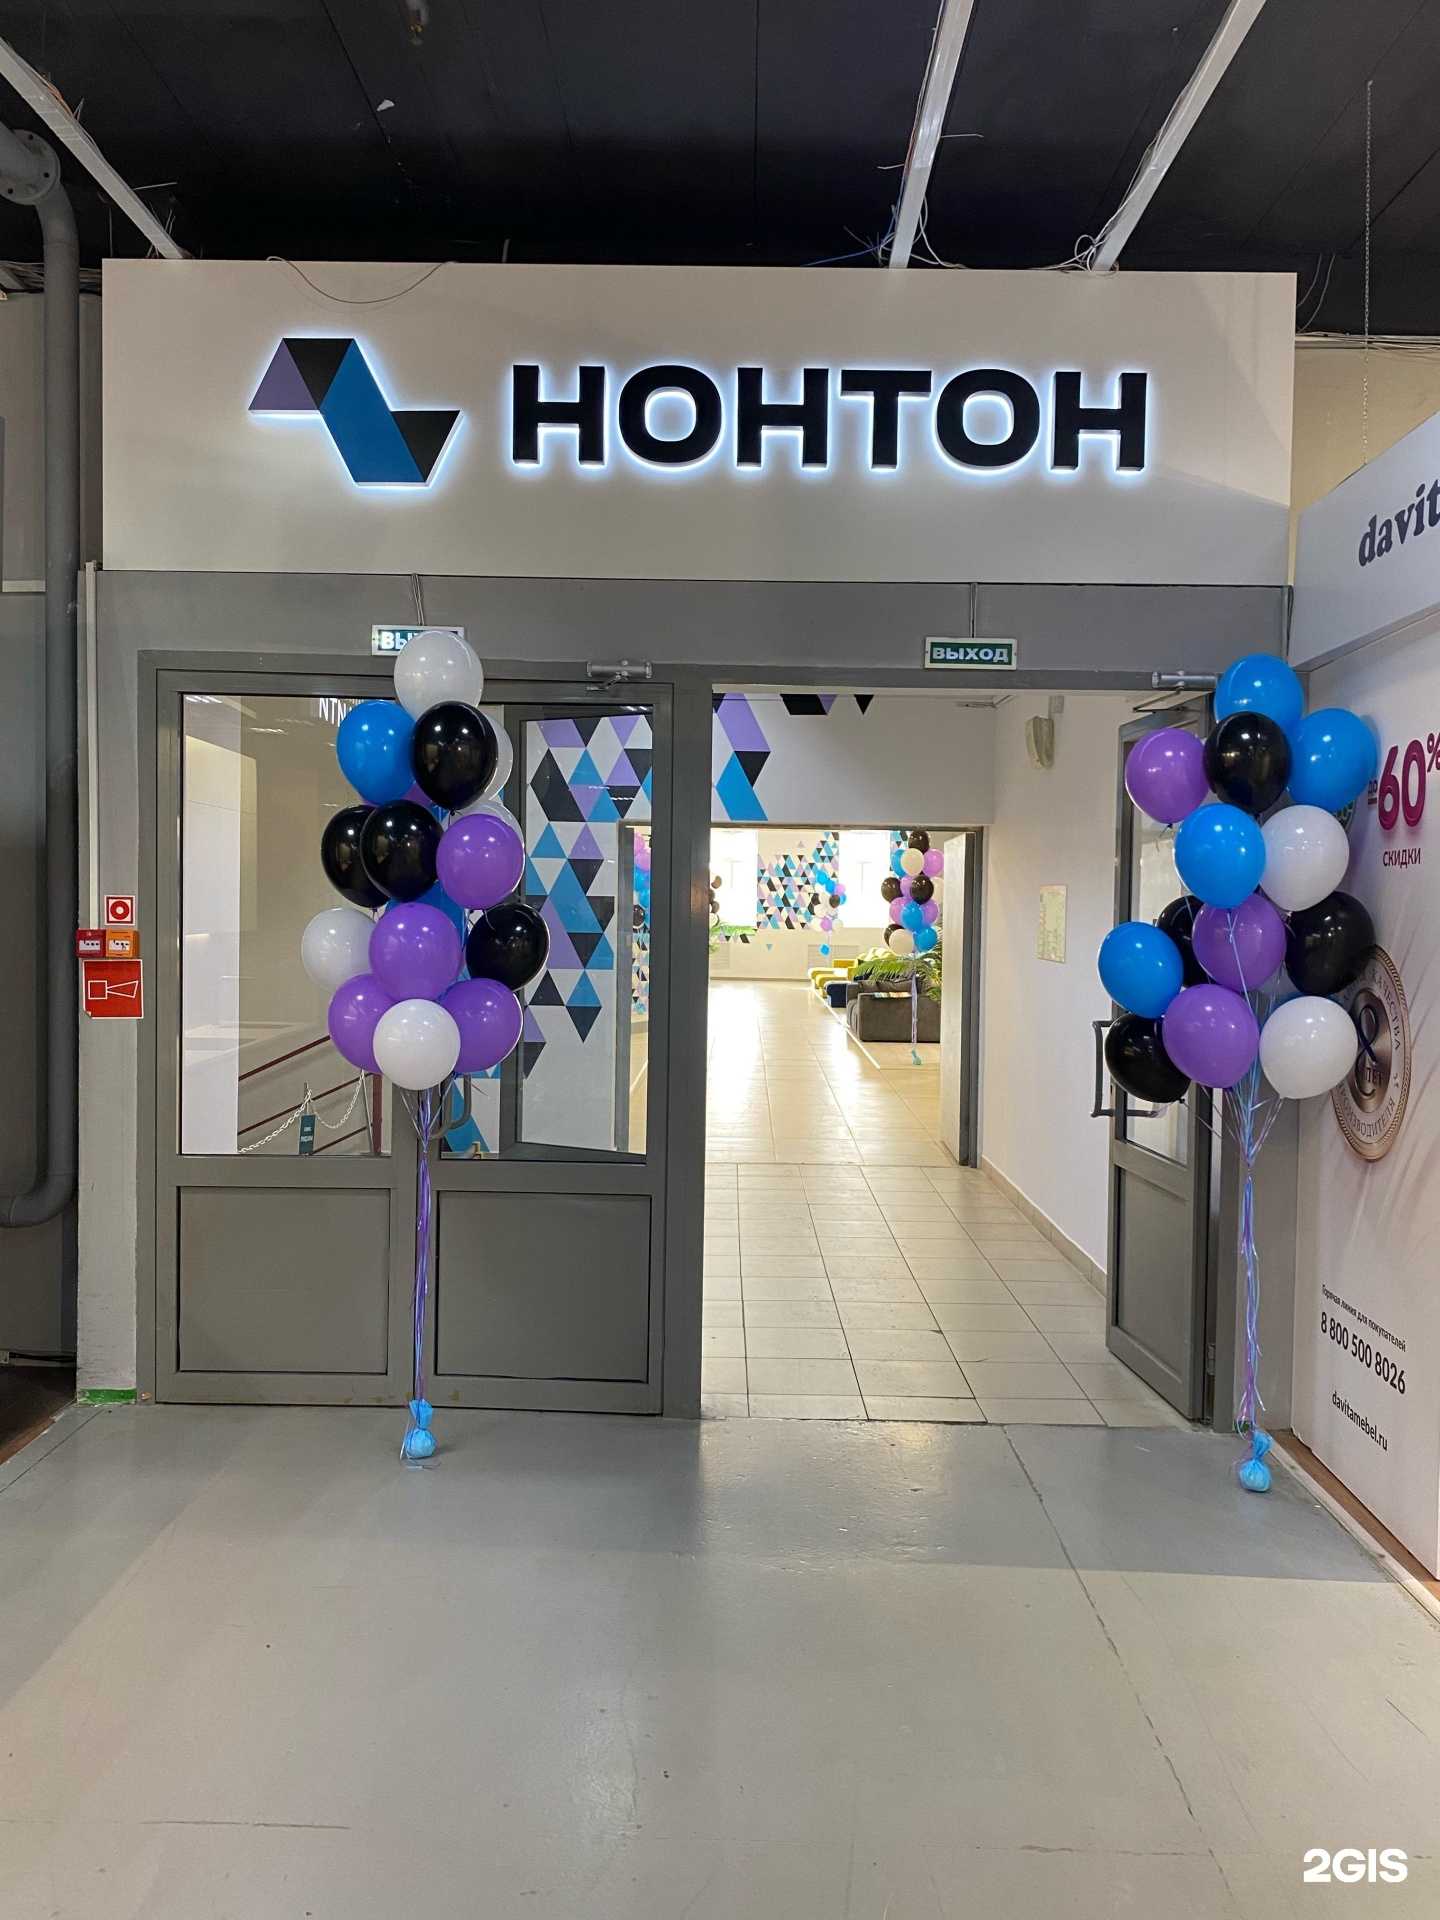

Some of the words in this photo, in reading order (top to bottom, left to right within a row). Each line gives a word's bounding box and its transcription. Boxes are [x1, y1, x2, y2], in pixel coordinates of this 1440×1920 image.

[512, 364, 1148, 471] НОНТОН
[932, 647, 1009, 663] ВЫХОД
[1321, 1311, 1327, 1334] 8
[1329, 1317, 1349, 1351] 800
[1351, 1333, 1372, 1369] 500
[1374, 1351, 1406, 1395] 8026
[1357, 1312, 1368, 1326] для
[1368, 1320, 1406, 1352] покупателей
[1332, 1391, 1388, 1451] davitamebel.ru
